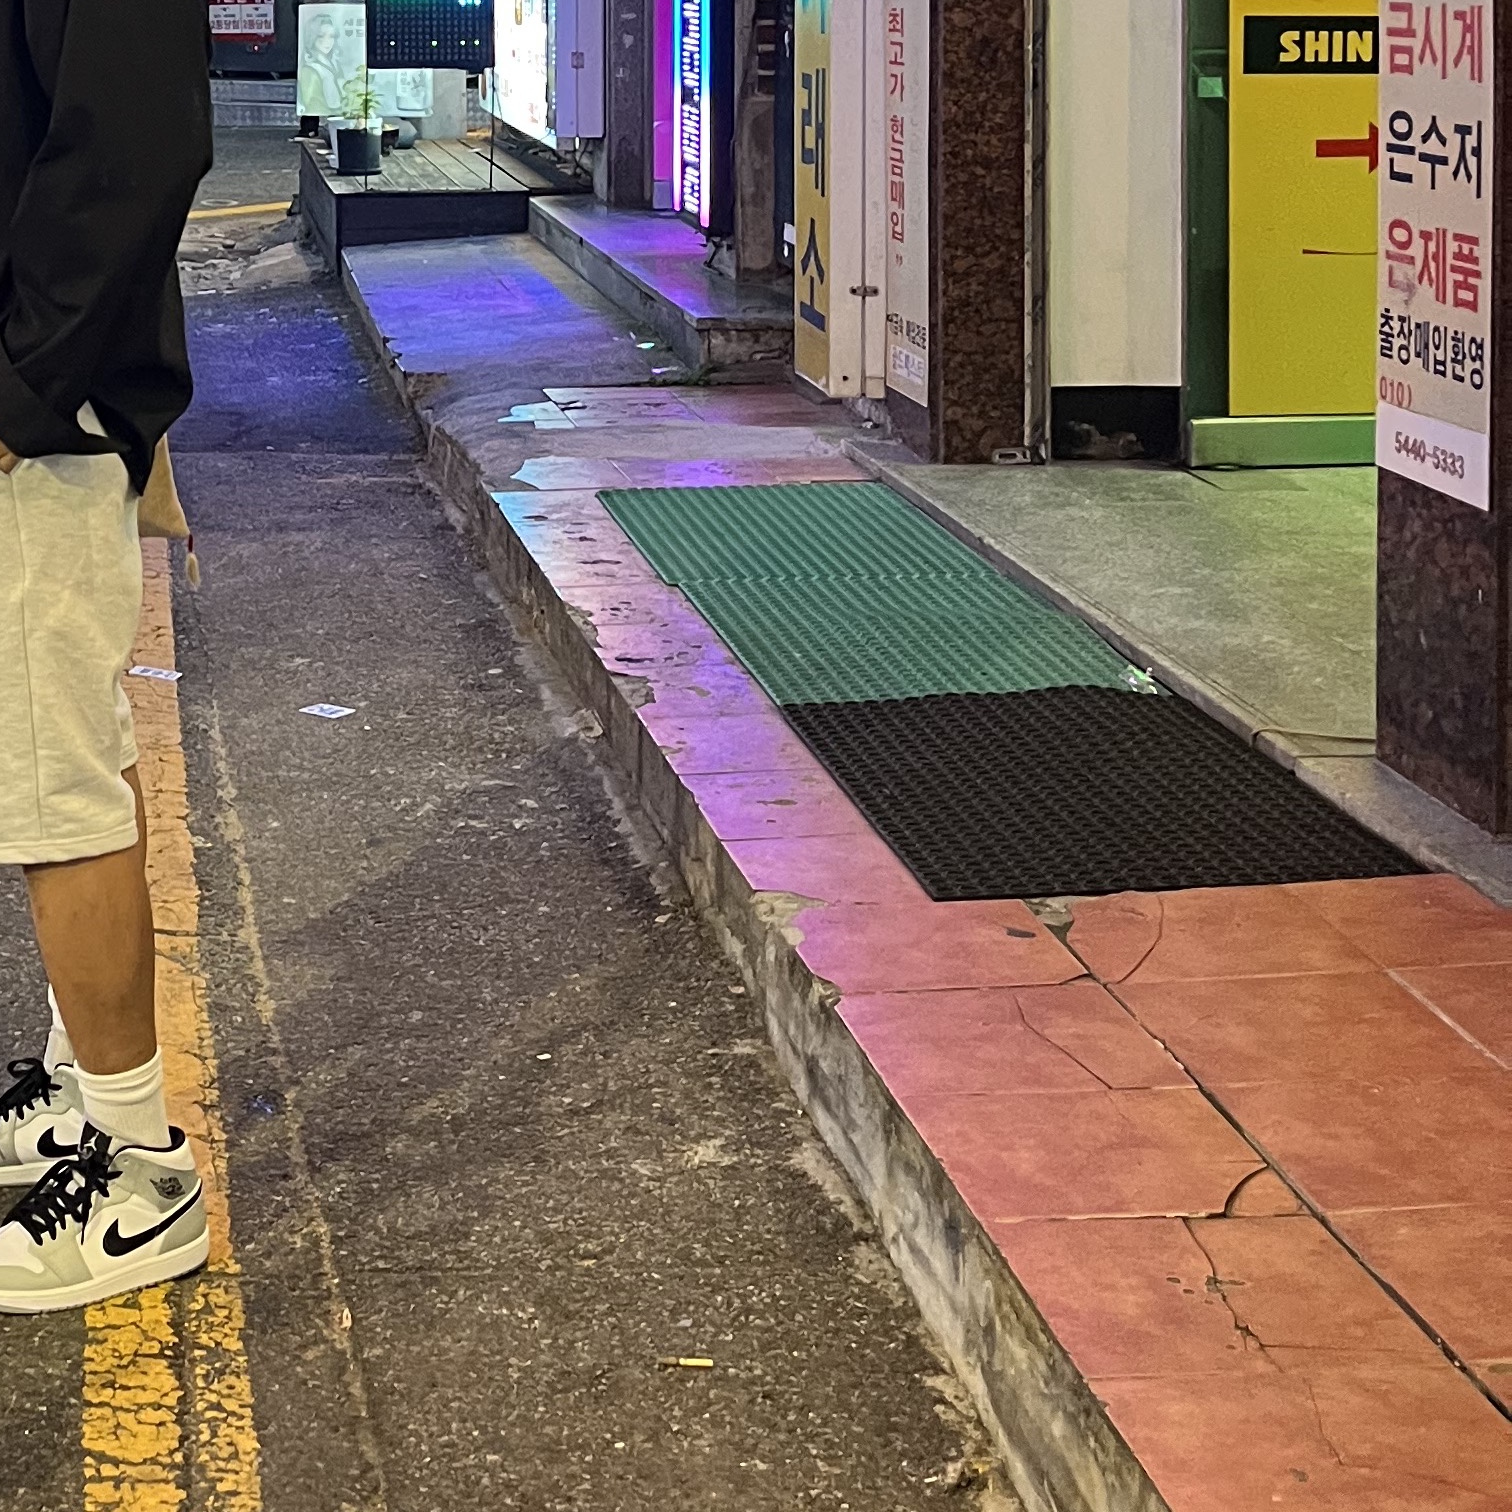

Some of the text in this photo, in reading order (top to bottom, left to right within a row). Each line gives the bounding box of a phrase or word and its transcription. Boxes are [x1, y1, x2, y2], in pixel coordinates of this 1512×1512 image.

[888, 7, 905, 103] 최고가
[1278, 32, 1373, 63] SHIN
[1386, 2, 1485, 83] 금시계
[1386, 110, 1483, 199] 은수저
[1385, 218, 1482, 313] 은제품
[1378, 307, 1485, 391] 출장매입환영
[1394, 430, 1465, 480] 5440-5333
